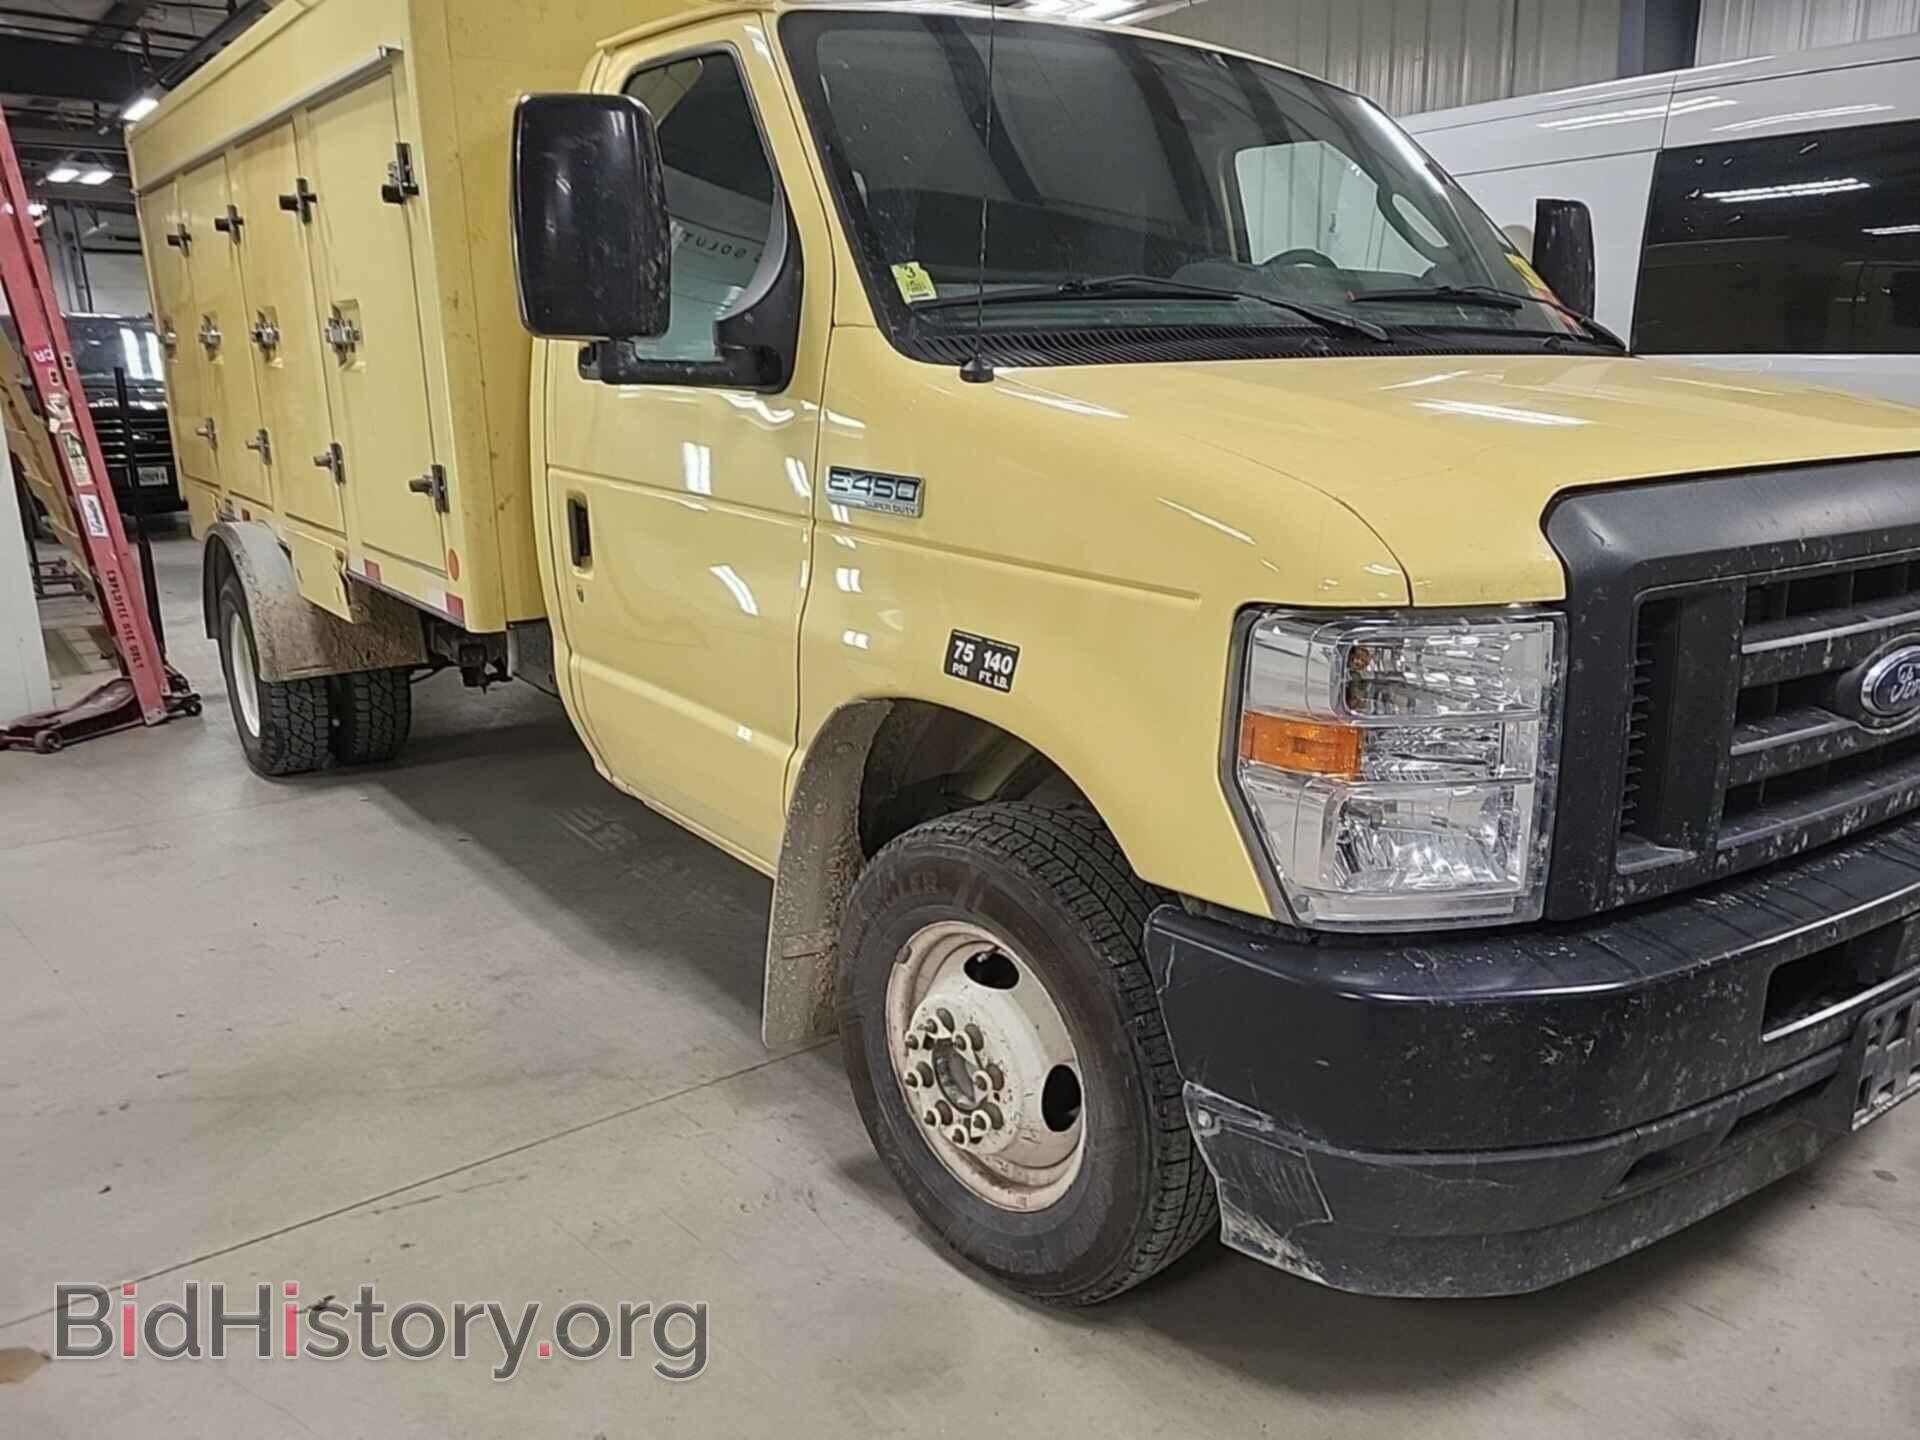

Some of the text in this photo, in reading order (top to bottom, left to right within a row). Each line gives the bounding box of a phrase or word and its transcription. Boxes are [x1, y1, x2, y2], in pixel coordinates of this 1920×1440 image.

[952, 662, 968, 677] PSI
[954, 640, 1013, 675] 75 140
